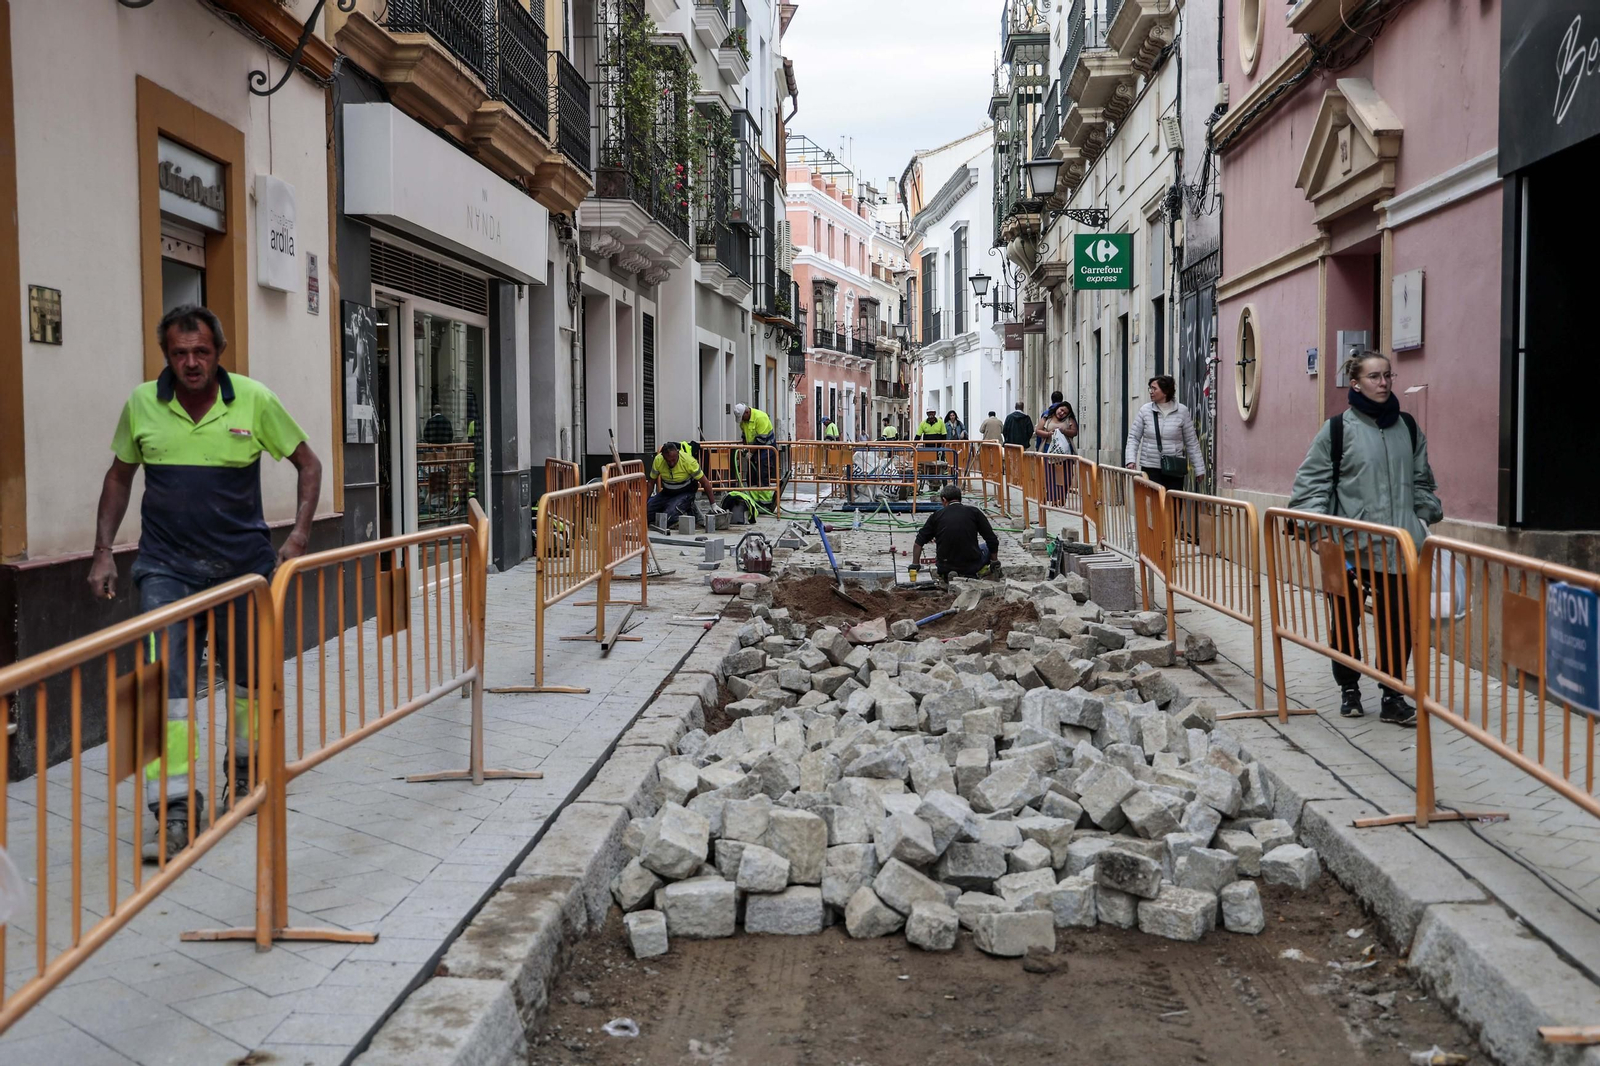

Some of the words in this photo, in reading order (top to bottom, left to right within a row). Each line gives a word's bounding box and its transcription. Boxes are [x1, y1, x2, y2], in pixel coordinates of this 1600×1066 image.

[1553, 14, 1600, 125] Be
[270, 227, 295, 257] ardila
[1080, 265, 1123, 274] Carrefour
[1086, 275, 1118, 284] express
